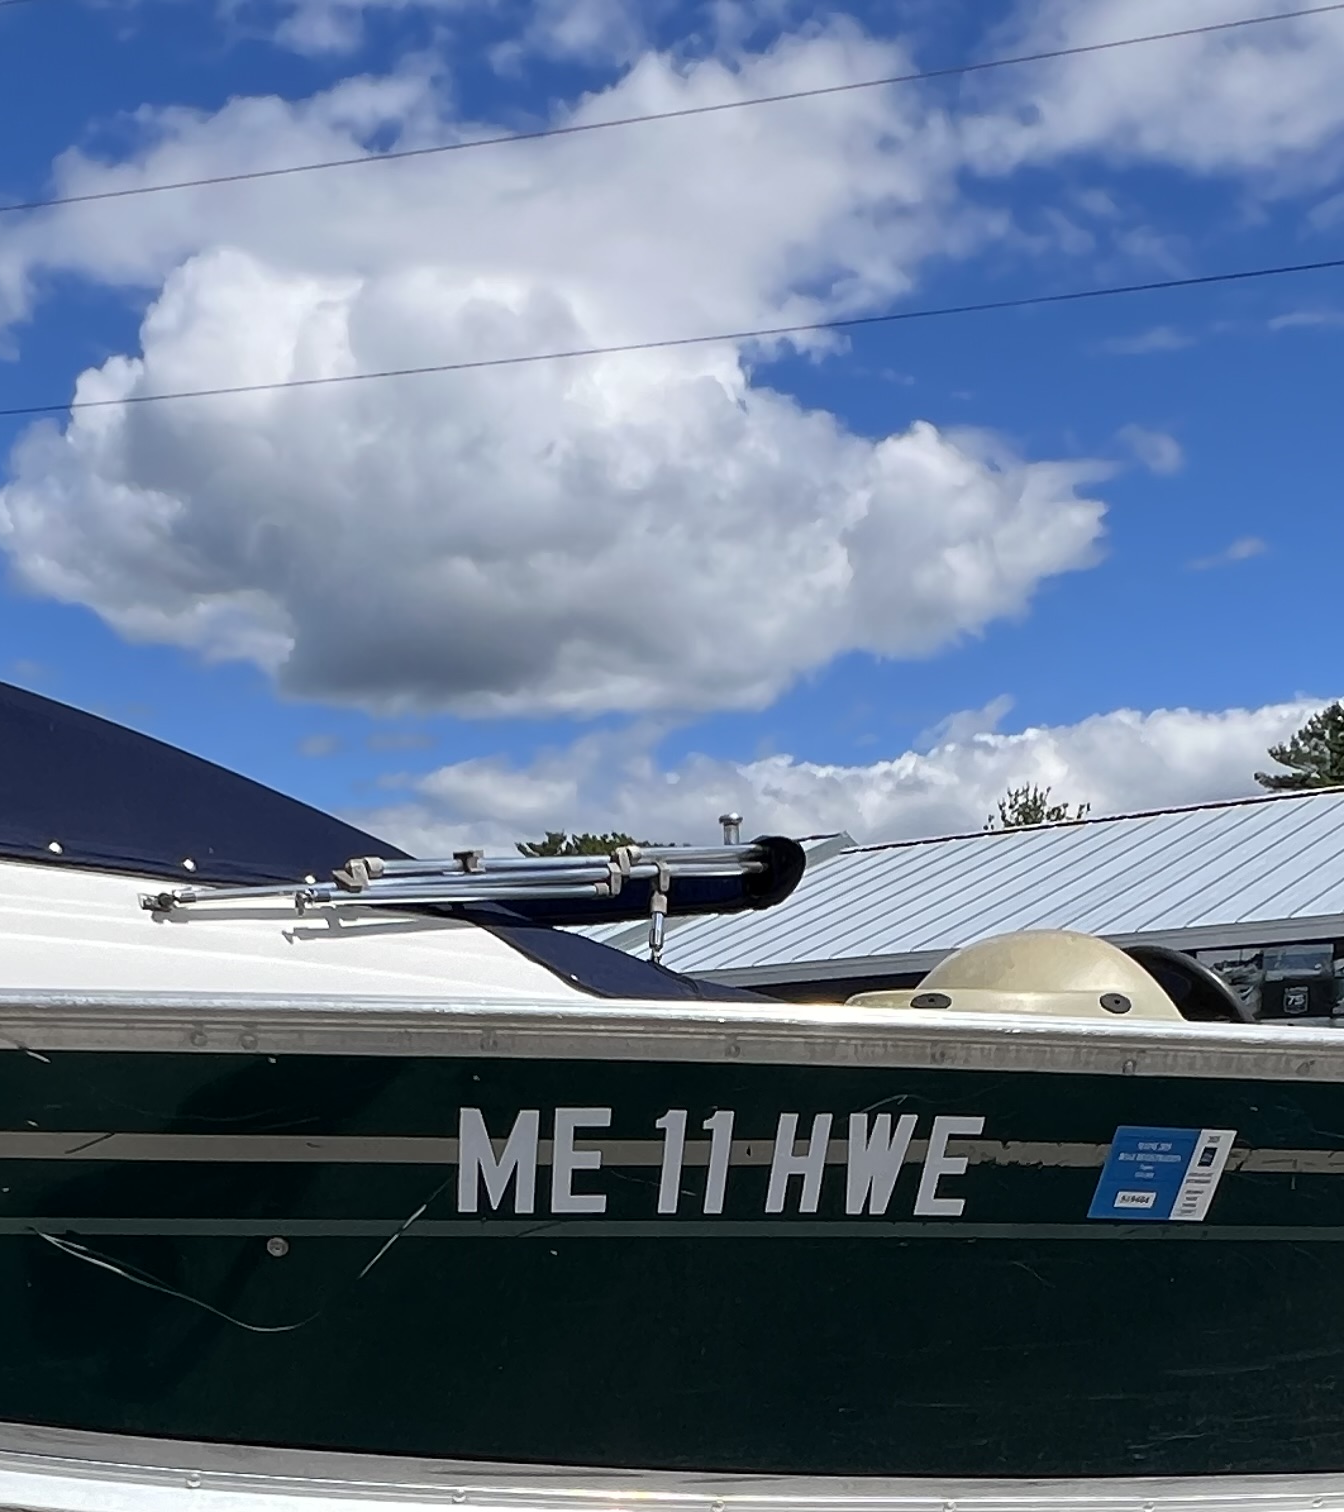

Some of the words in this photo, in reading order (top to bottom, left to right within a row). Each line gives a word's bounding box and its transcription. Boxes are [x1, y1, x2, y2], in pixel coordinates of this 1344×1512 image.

[457, 1107, 612, 1213] ME
[656, 1109, 734, 1213] 11
[764, 1112, 985, 1216] HWE
